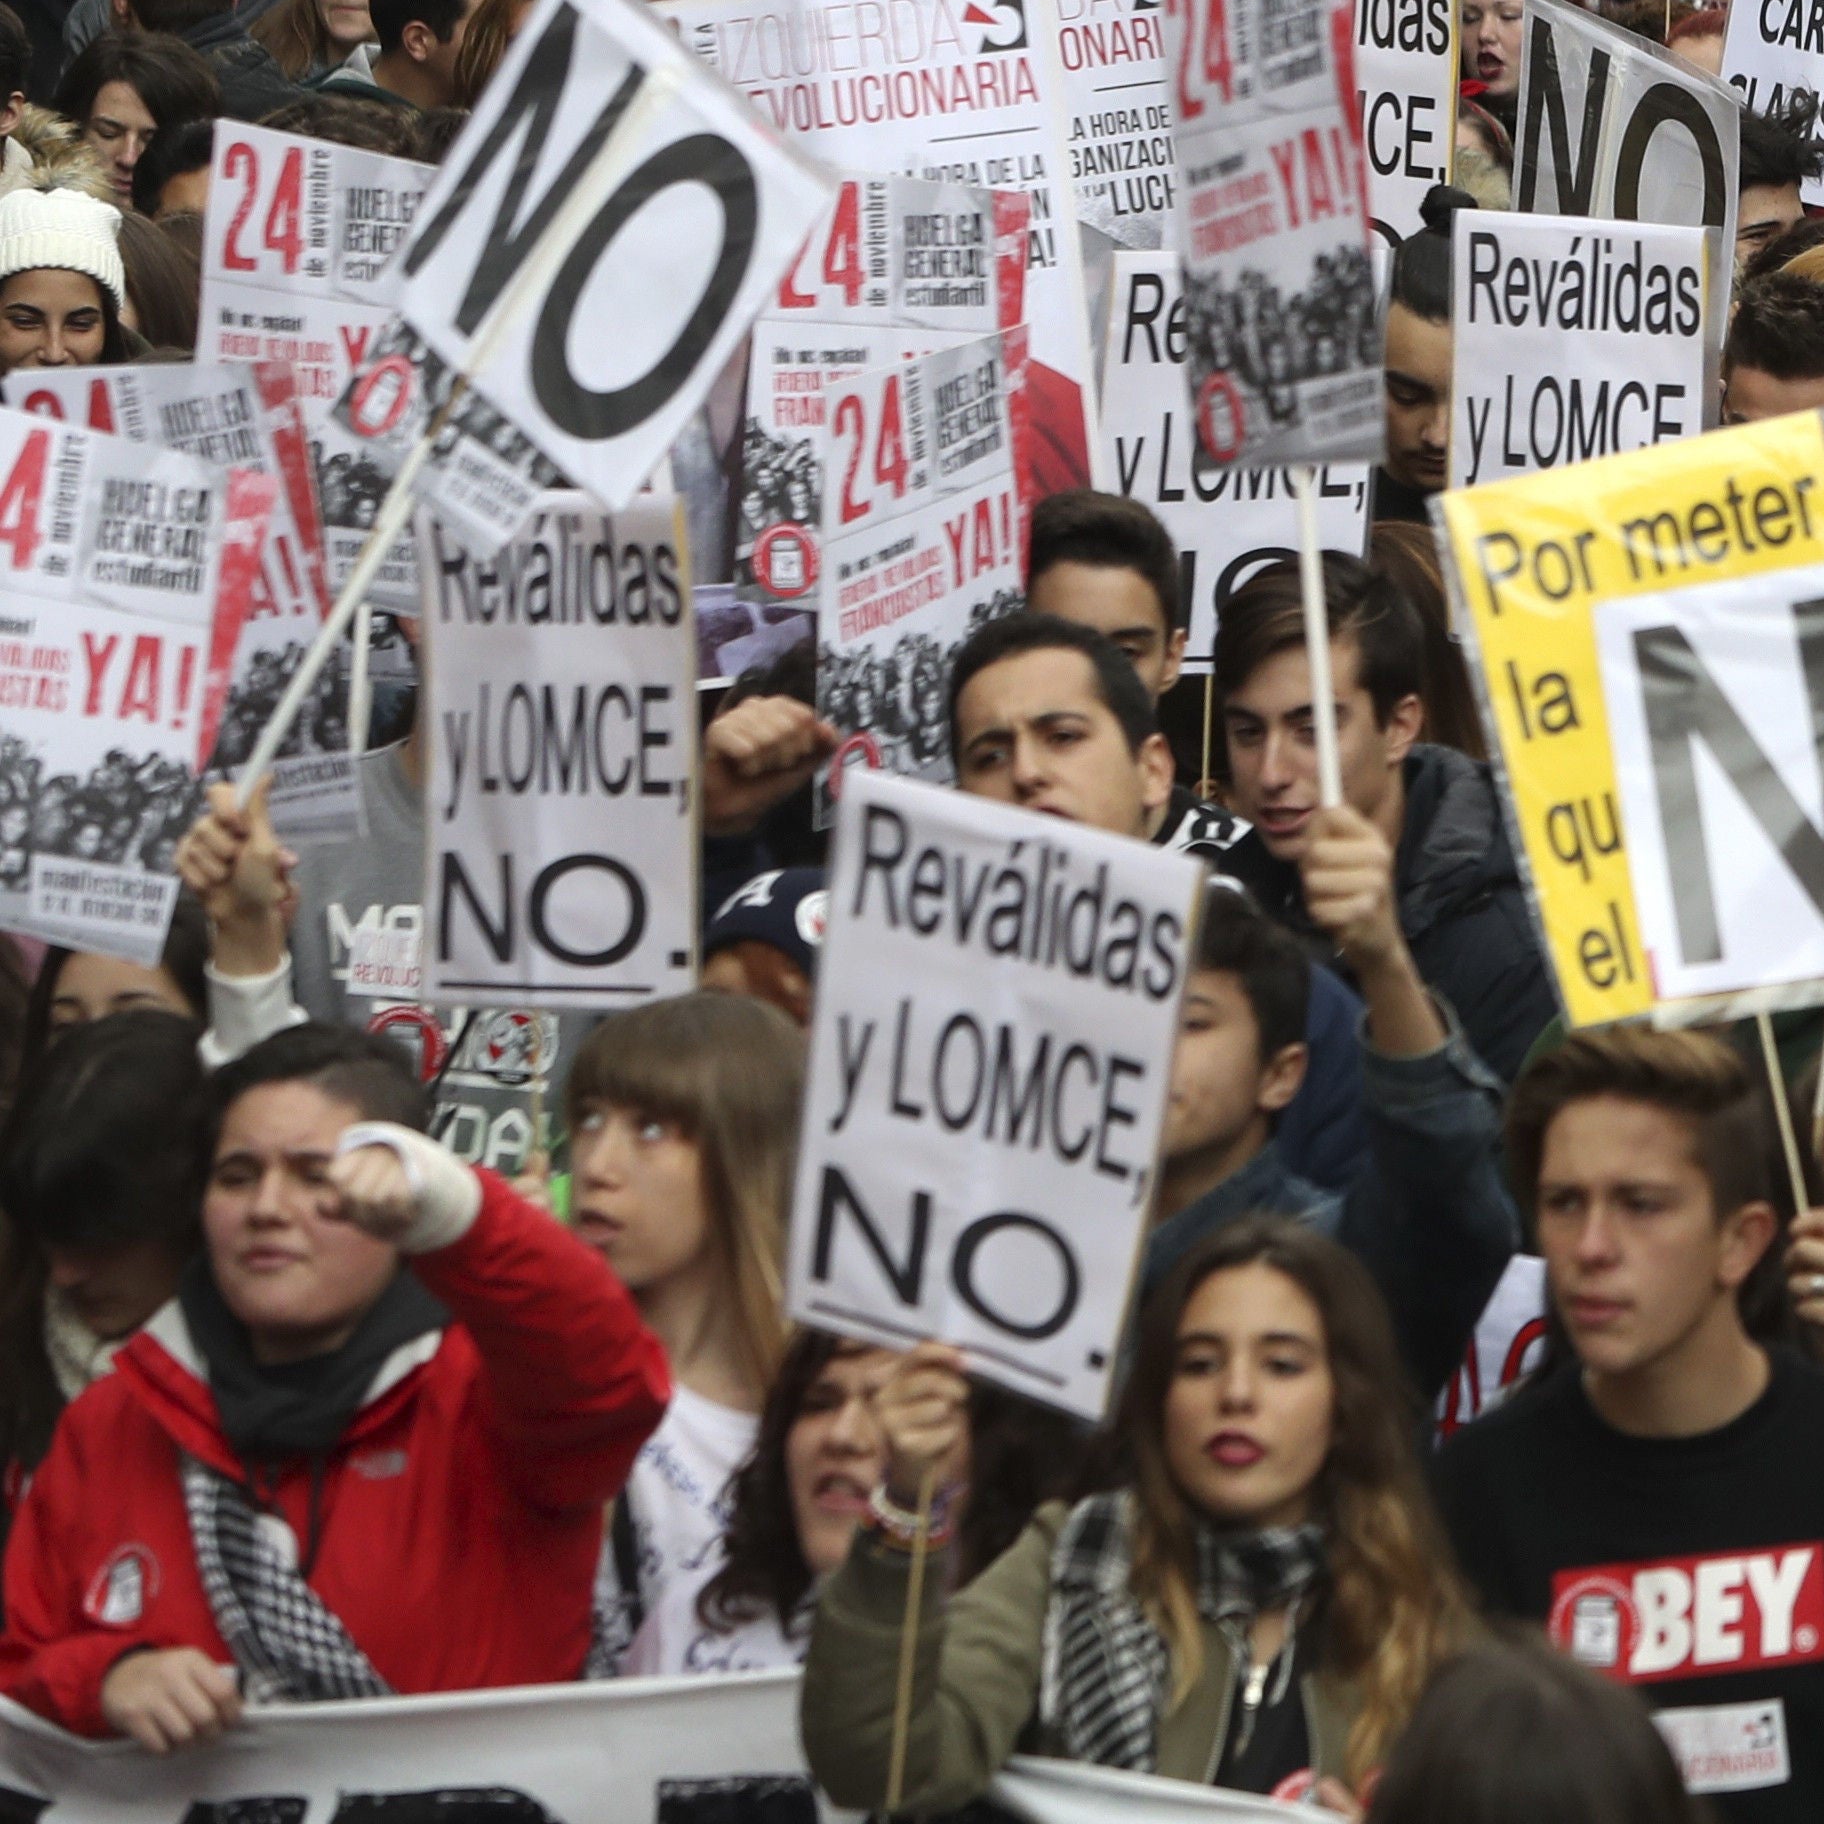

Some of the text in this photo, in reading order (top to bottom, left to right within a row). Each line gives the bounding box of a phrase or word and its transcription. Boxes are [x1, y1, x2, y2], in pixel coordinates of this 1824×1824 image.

[1090, 104, 1170, 139] HORA DE
[221, 141, 304, 275] 24
[903, 213, 984, 247] HUELGA
[903, 249, 986, 279] GENERAL
[1466, 229, 1702, 339] Reválidas
[833, 374, 911, 526] 24
[100, 518, 207, 561] GENERAL
[944, 490, 1015, 592] YA!
[1476, 474, 1816, 618] Por meter
[81, 630, 198, 730] YA!
[1505, 658, 1581, 743] la
[437, 850, 689, 967] NO.
[850, 799, 1188, 1004] Reválidas
[1577, 900, 1636, 992] el
[827, 998, 1153, 1212] y LOMCE,
[811, 1165, 1109, 1373] NO.
